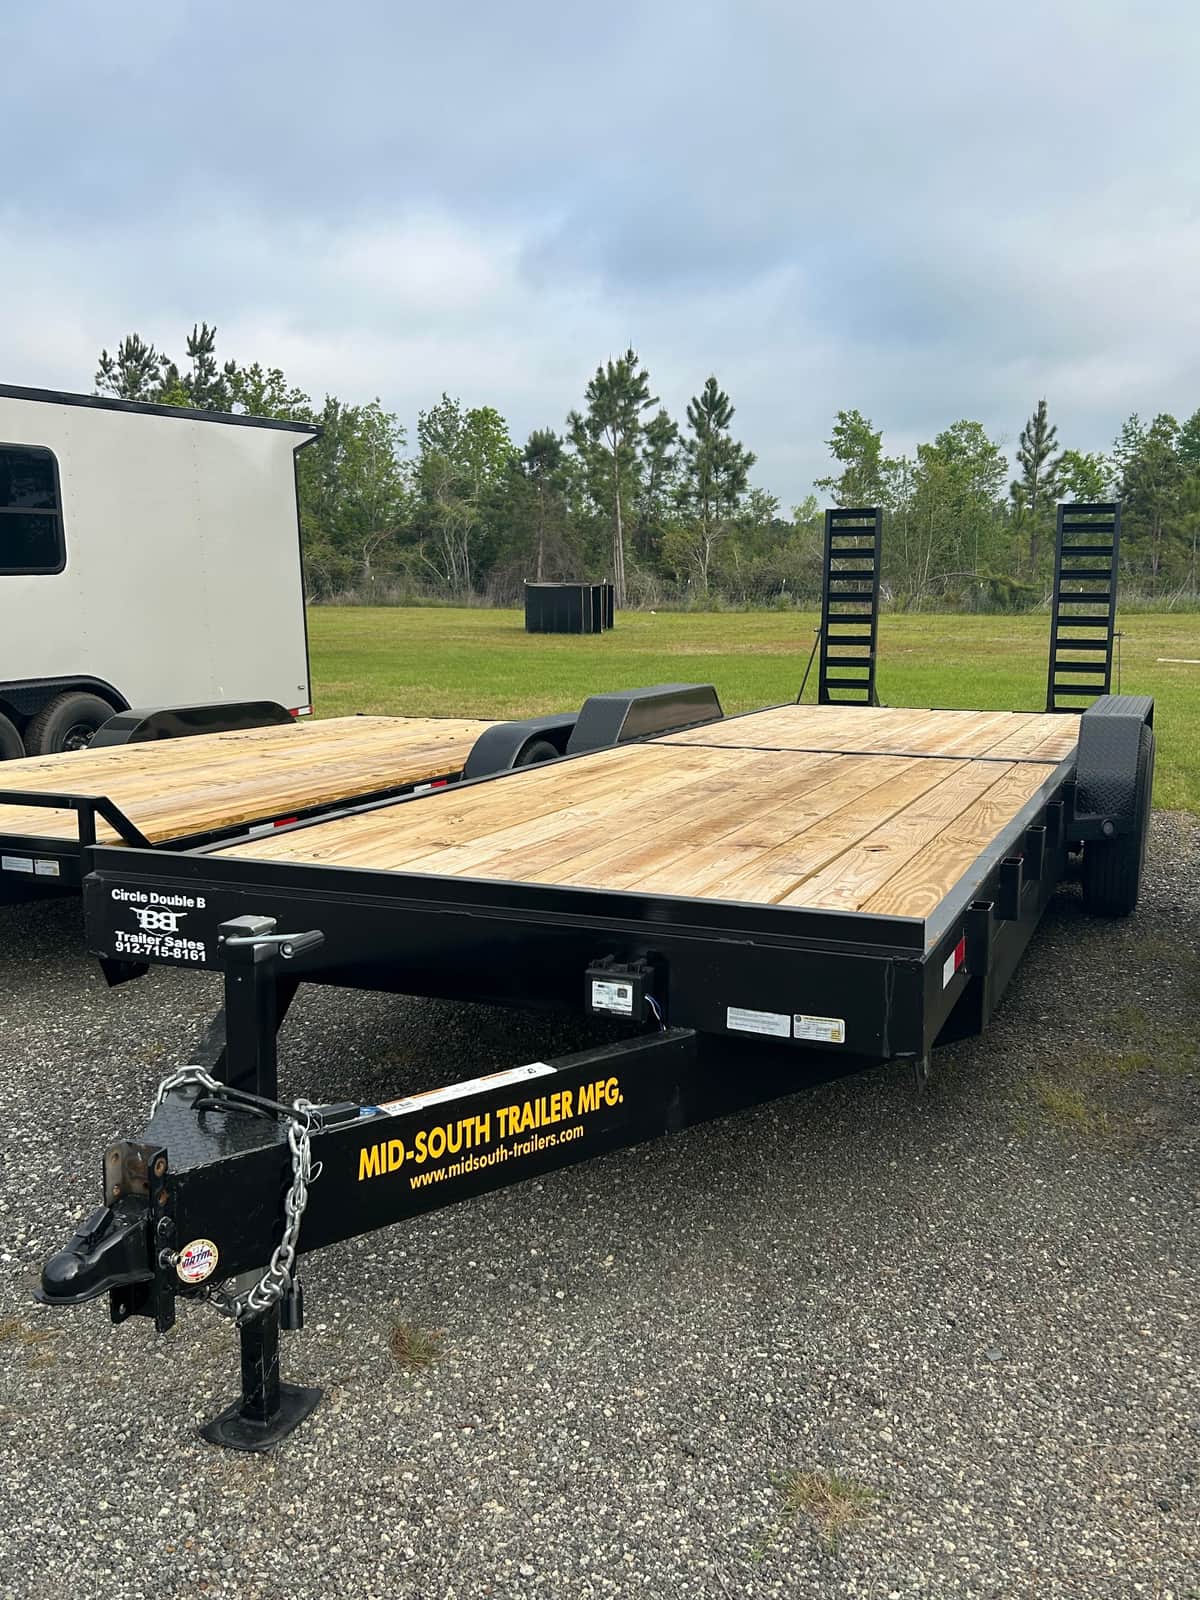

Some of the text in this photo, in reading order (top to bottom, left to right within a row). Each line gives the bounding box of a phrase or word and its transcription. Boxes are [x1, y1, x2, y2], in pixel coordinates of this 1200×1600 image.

[111, 888, 206, 908] Circle Double B
[115, 930, 205, 950] Trailer Sales
[115, 941, 206, 962] 912-715-8161
[358, 1077, 624, 1181] MID-SOUTH TRAILER MFG.
[410, 1124, 584, 1190] www.midsouth-trailers.com
